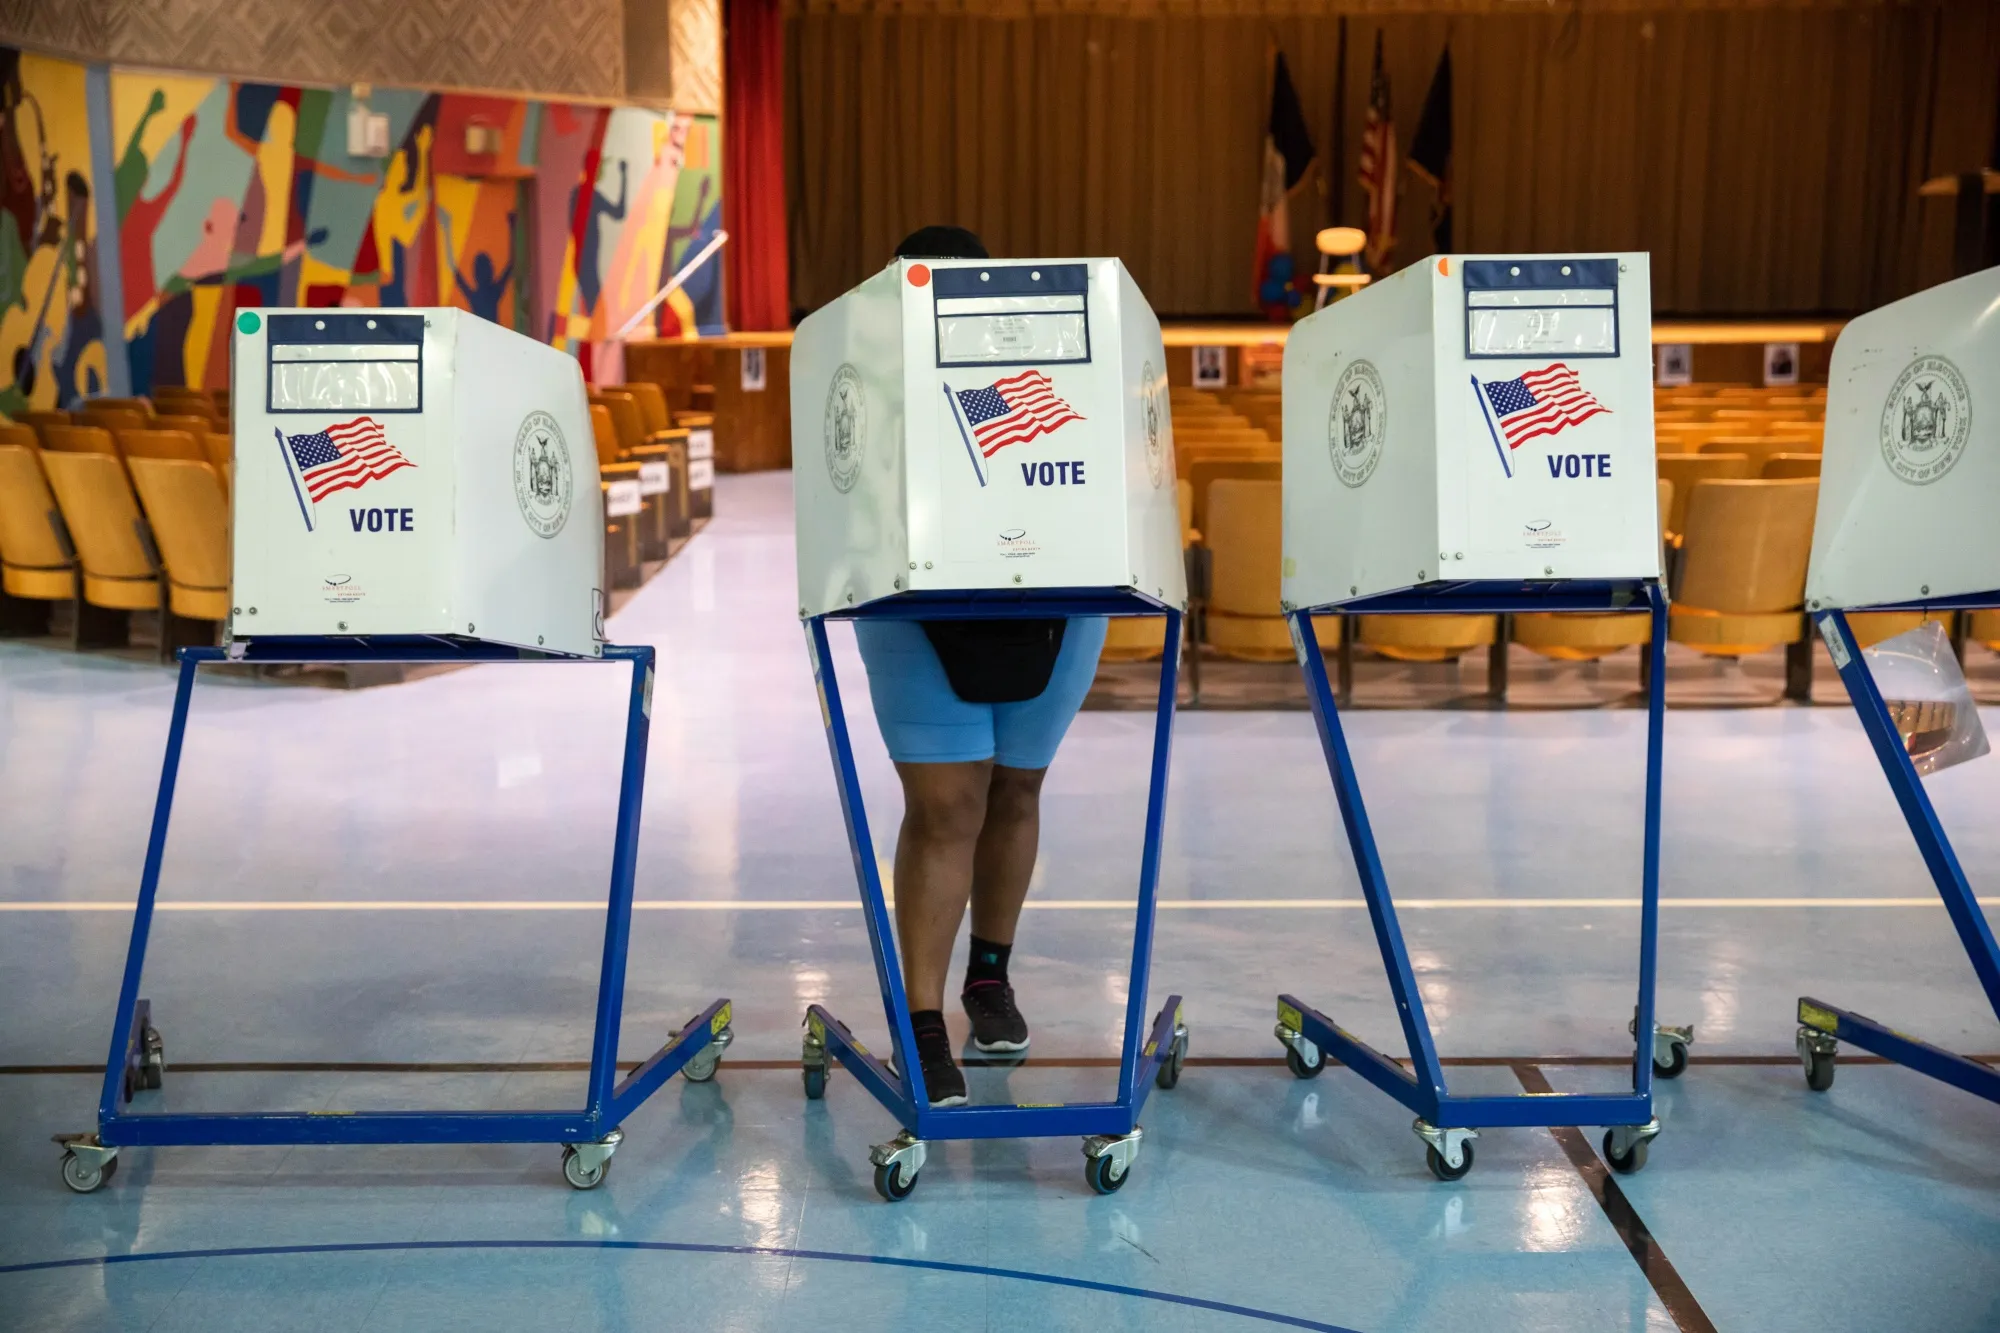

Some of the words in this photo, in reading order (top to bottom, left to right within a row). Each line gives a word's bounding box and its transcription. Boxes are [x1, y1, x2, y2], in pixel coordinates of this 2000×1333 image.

[1913, 361, 1925, 375] OF
[1021, 461, 1085, 486] VOTE
[1548, 454, 1611, 478] VOTE
[1896, 462, 1917, 479] CITY
[1918, 467, 1930, 479] OF
[350, 508, 413, 532] VOTE
